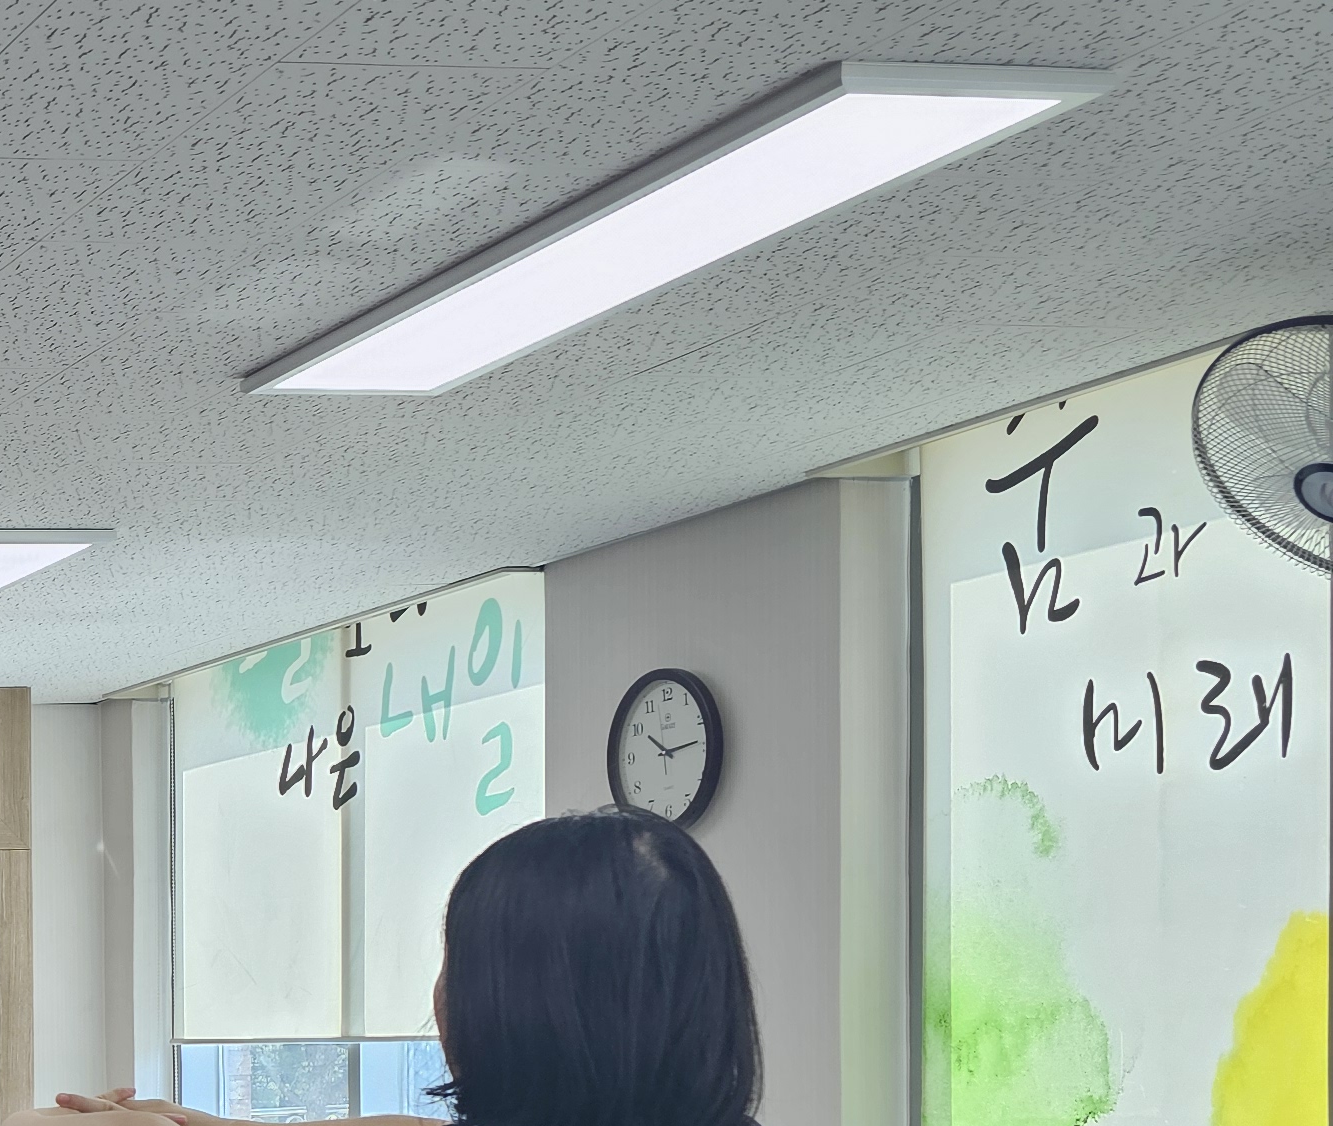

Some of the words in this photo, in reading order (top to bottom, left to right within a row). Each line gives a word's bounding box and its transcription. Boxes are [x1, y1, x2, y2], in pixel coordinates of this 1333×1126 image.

[661, 687, 673, 702] 12
[683, 692, 690, 706] 1
[644, 700, 656, 714] 11
[1082, 652, 1293, 775] 미래
[632, 722, 644, 737] 10
[278, 704, 361, 811] 나은
[627, 752, 636, 765] 9
[633, 781, 642, 794] 8
[648, 799, 655, 812] 7
[665, 804, 673, 818] 6
